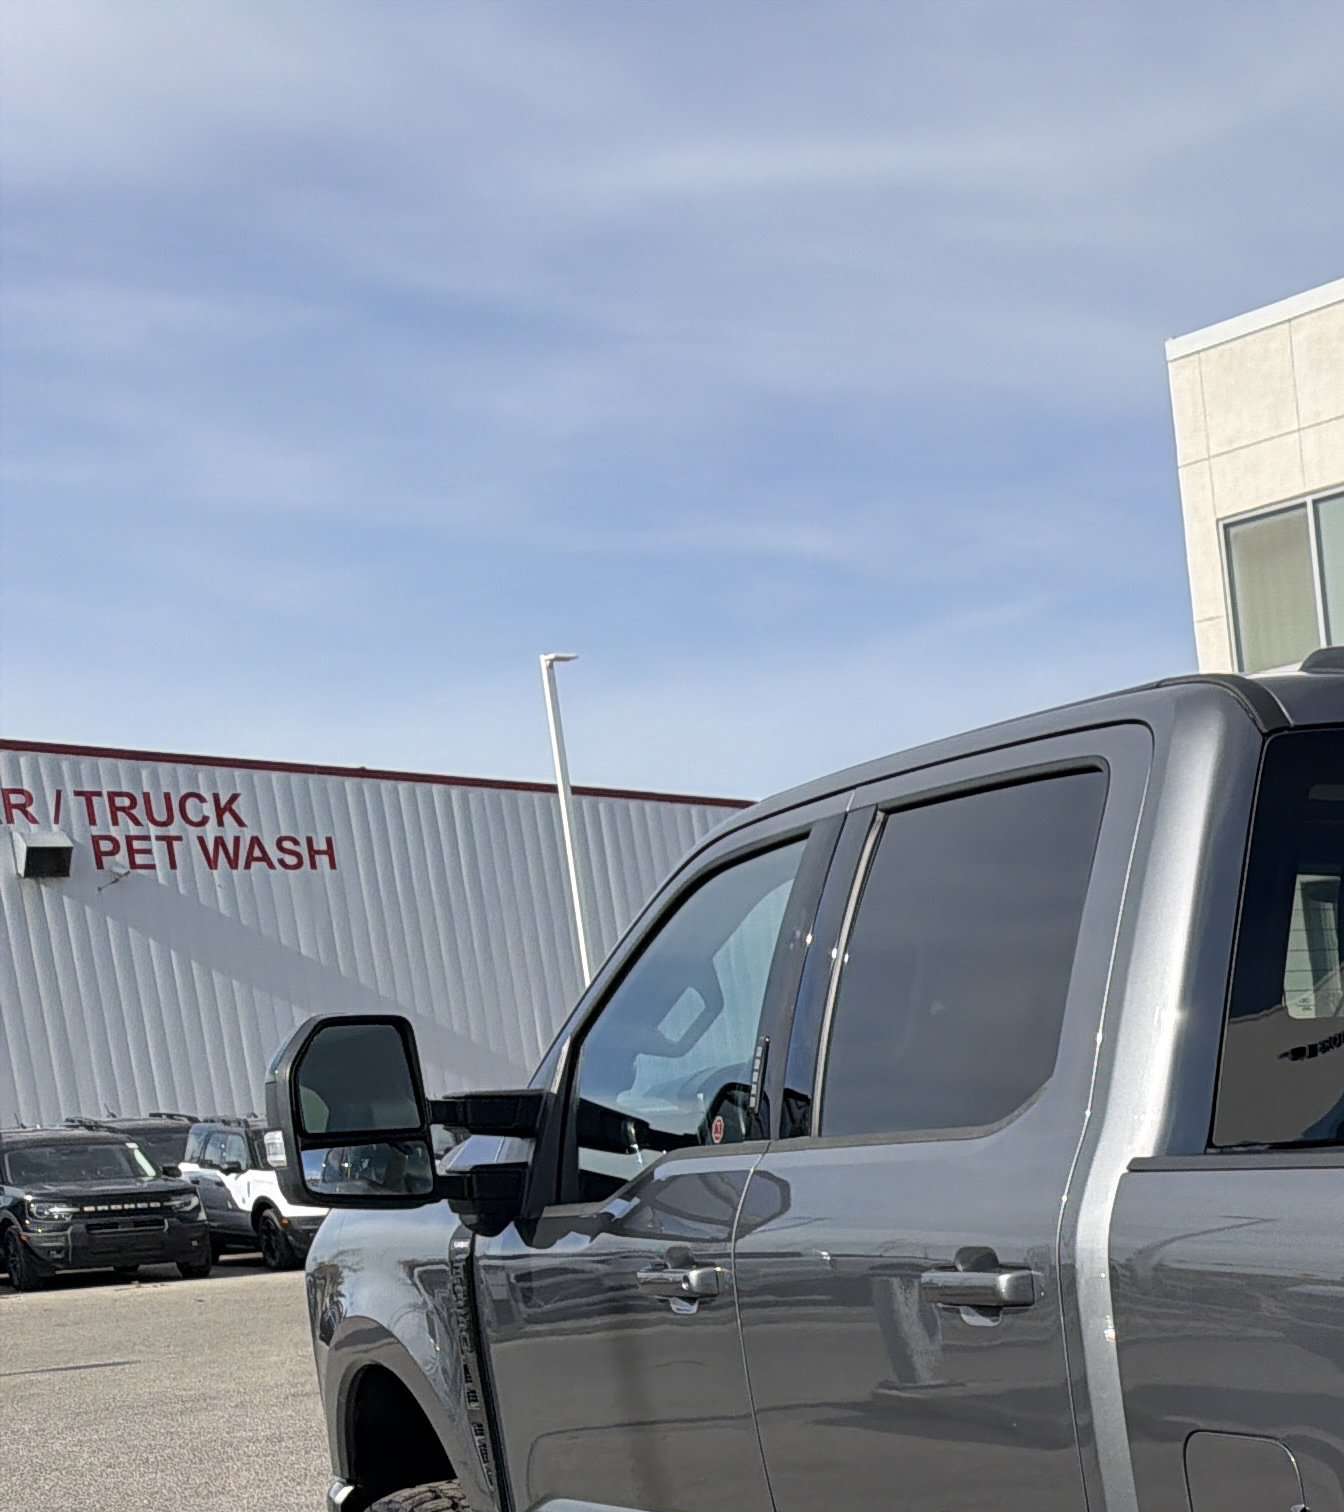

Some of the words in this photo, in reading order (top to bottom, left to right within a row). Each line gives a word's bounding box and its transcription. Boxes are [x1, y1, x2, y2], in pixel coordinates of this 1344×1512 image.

[0, 787, 39, 825] R
[73, 789, 248, 828] TRUCK
[90, 834, 183, 871] PET
[197, 835, 337, 871] WASH
